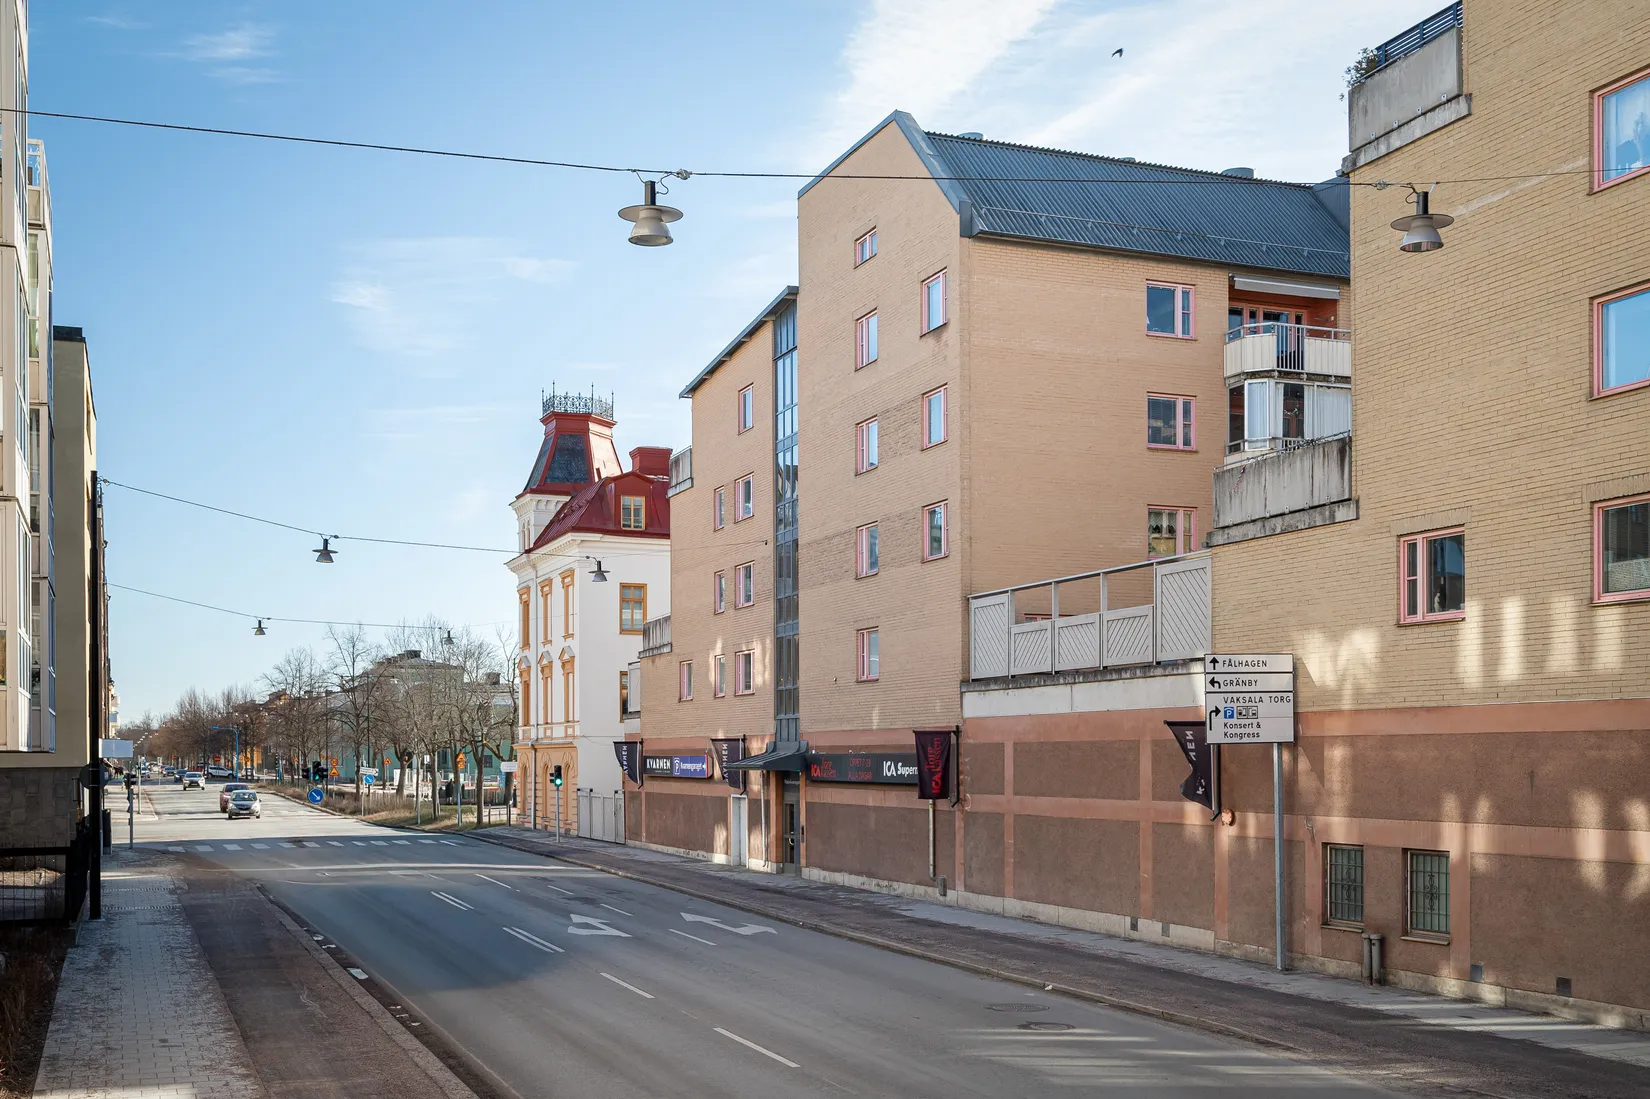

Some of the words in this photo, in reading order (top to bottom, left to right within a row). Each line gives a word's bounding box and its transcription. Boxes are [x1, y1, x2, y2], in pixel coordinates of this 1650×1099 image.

[1222, 658, 1267, 668] FÅLHAGEN
[1222, 677, 1259, 687] GRÄNBY
[1223, 696, 1264, 704] VAKSALA
[1268, 695, 1291, 704] TORG
[1223, 721, 1254, 730] Konsert
[1255, 721, 1261, 729] &
[1223, 731, 1261, 740] Kongress
[646, 758, 671, 770] KVARNEN
[883, 760, 896, 777] ICA
[811, 764, 820, 777] ICA
[931, 772, 942, 794] ICA
